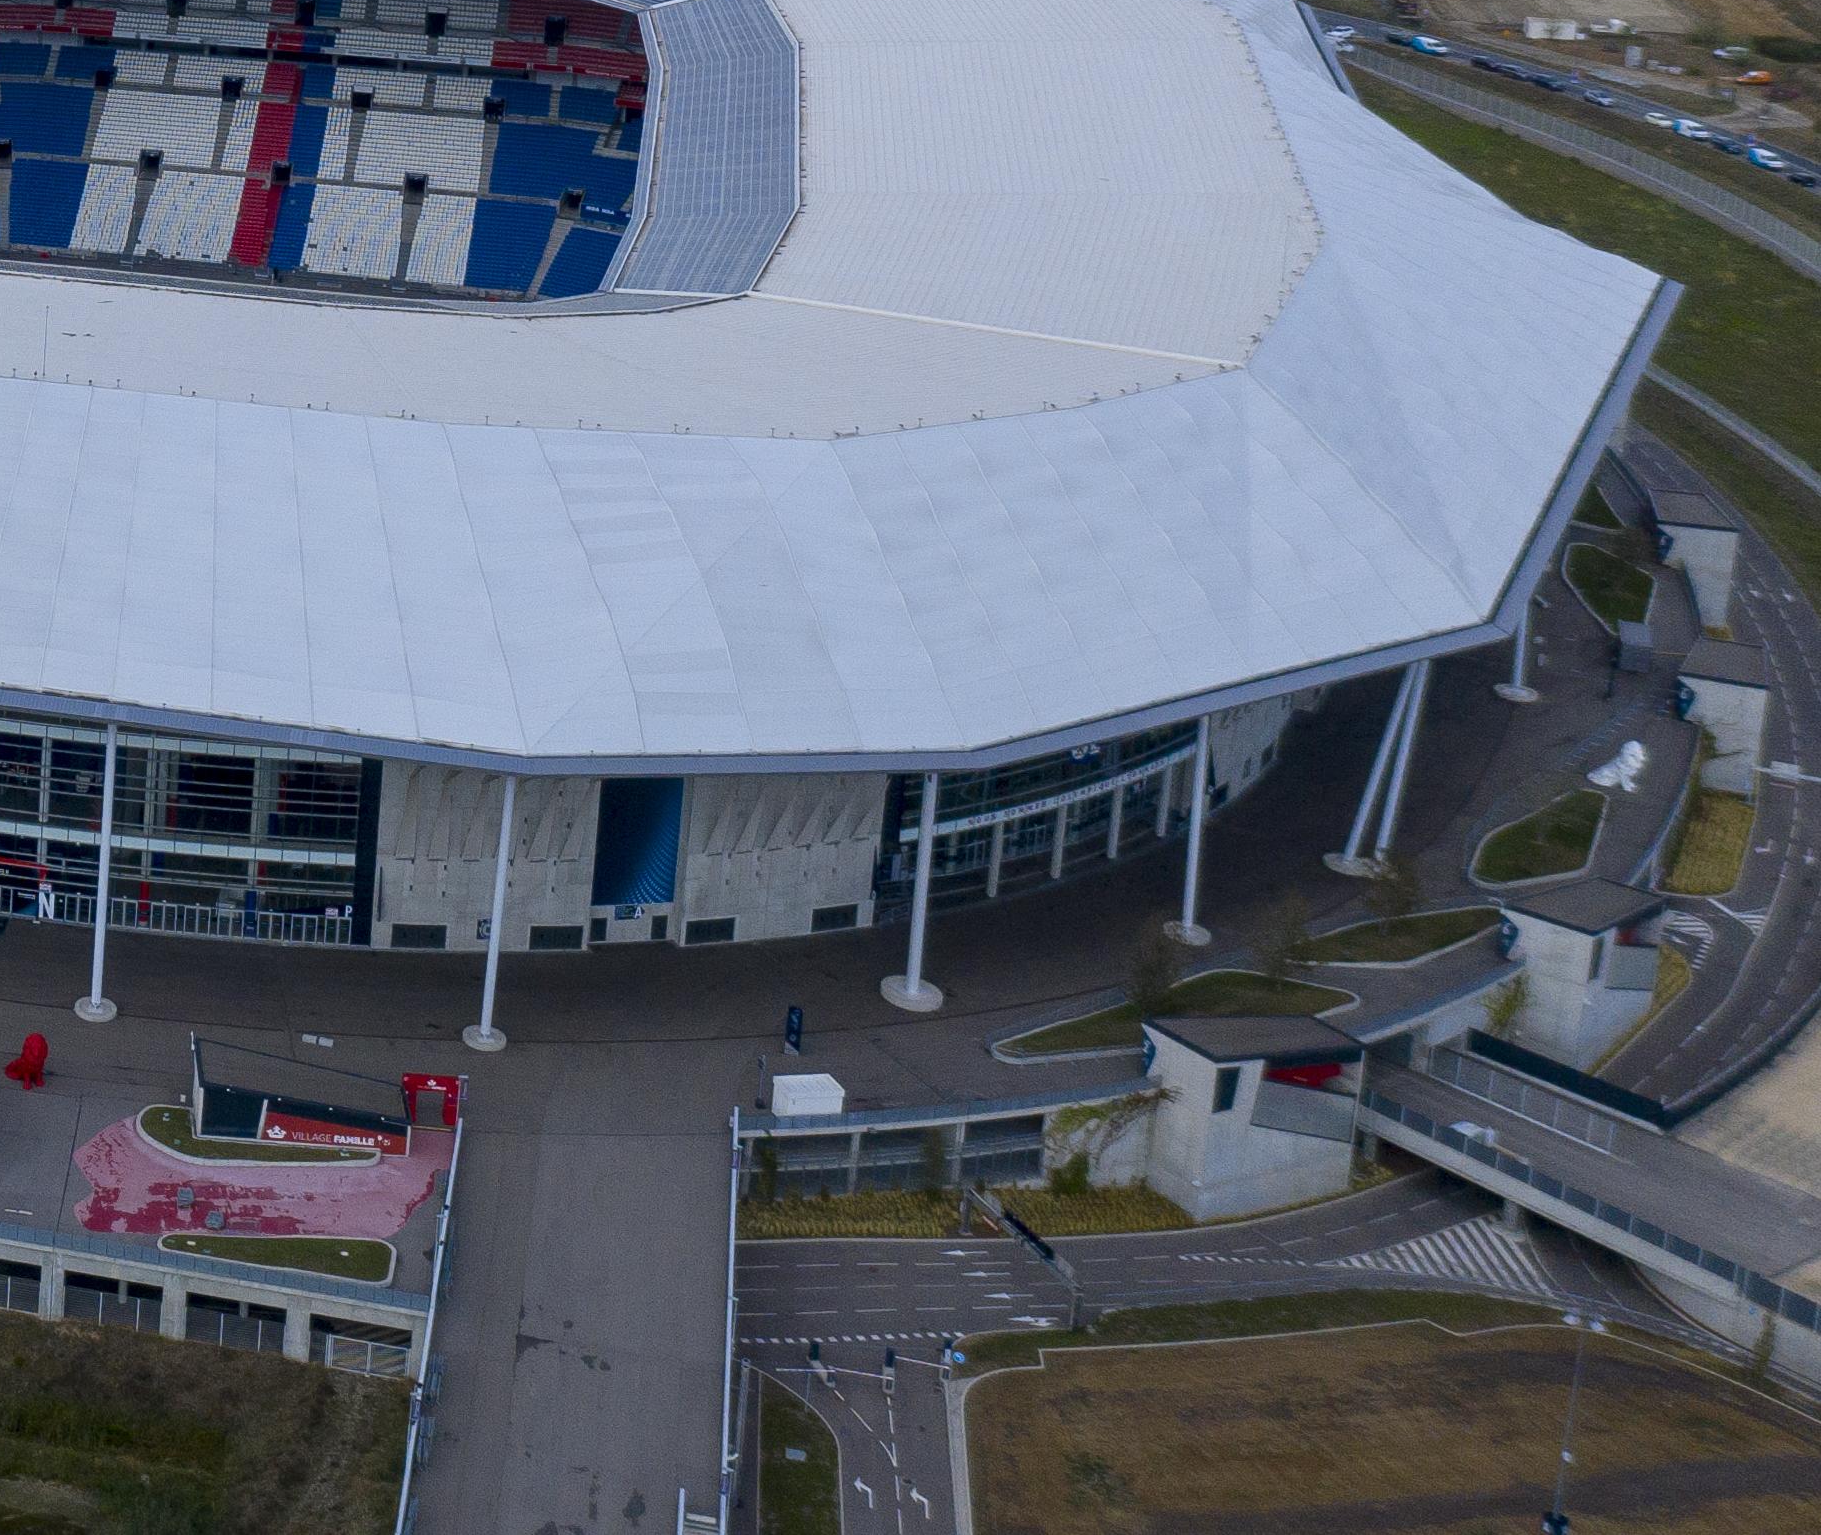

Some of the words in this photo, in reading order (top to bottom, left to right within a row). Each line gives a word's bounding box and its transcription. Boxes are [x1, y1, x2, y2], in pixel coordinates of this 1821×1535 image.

[38, 891, 55, 920] N
[345, 905, 353, 918] P
[634, 906, 642, 919] A
[292, 1131, 332, 1143] VILLAGE
[333, 1136, 375, 1146] FAMILLE
